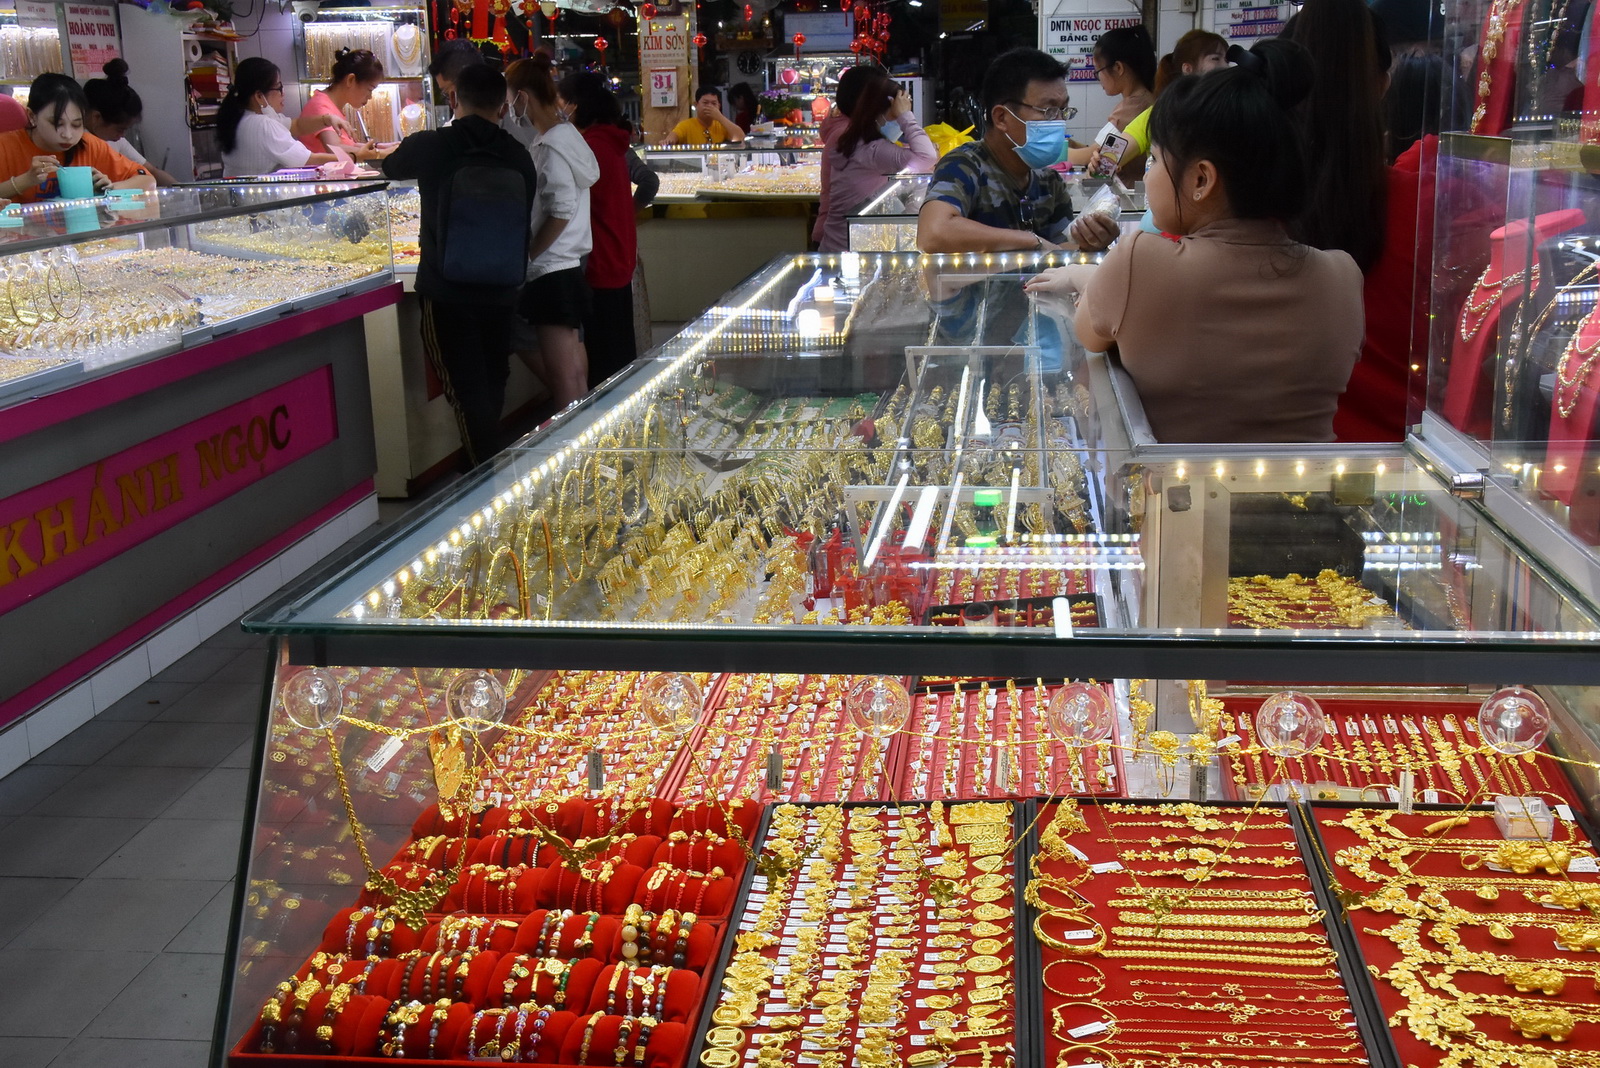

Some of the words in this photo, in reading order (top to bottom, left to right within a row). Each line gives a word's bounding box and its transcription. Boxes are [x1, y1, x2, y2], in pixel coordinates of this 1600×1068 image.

[69, 18, 96, 36] HOÀNG
[96, 23, 115, 37] VINH
[1051, 20, 1071, 31] DNTN
[1074, 19, 1101, 33] NGỌC
[643, 36, 662, 50] KIM
[666, 34, 685, 50] SƠN
[1060, 33, 1088, 42] BẢNG
[654, 74, 672, 89] 31
[0, 452, 184, 587] KHÁNH
[194, 405, 292, 489] NGỌC
